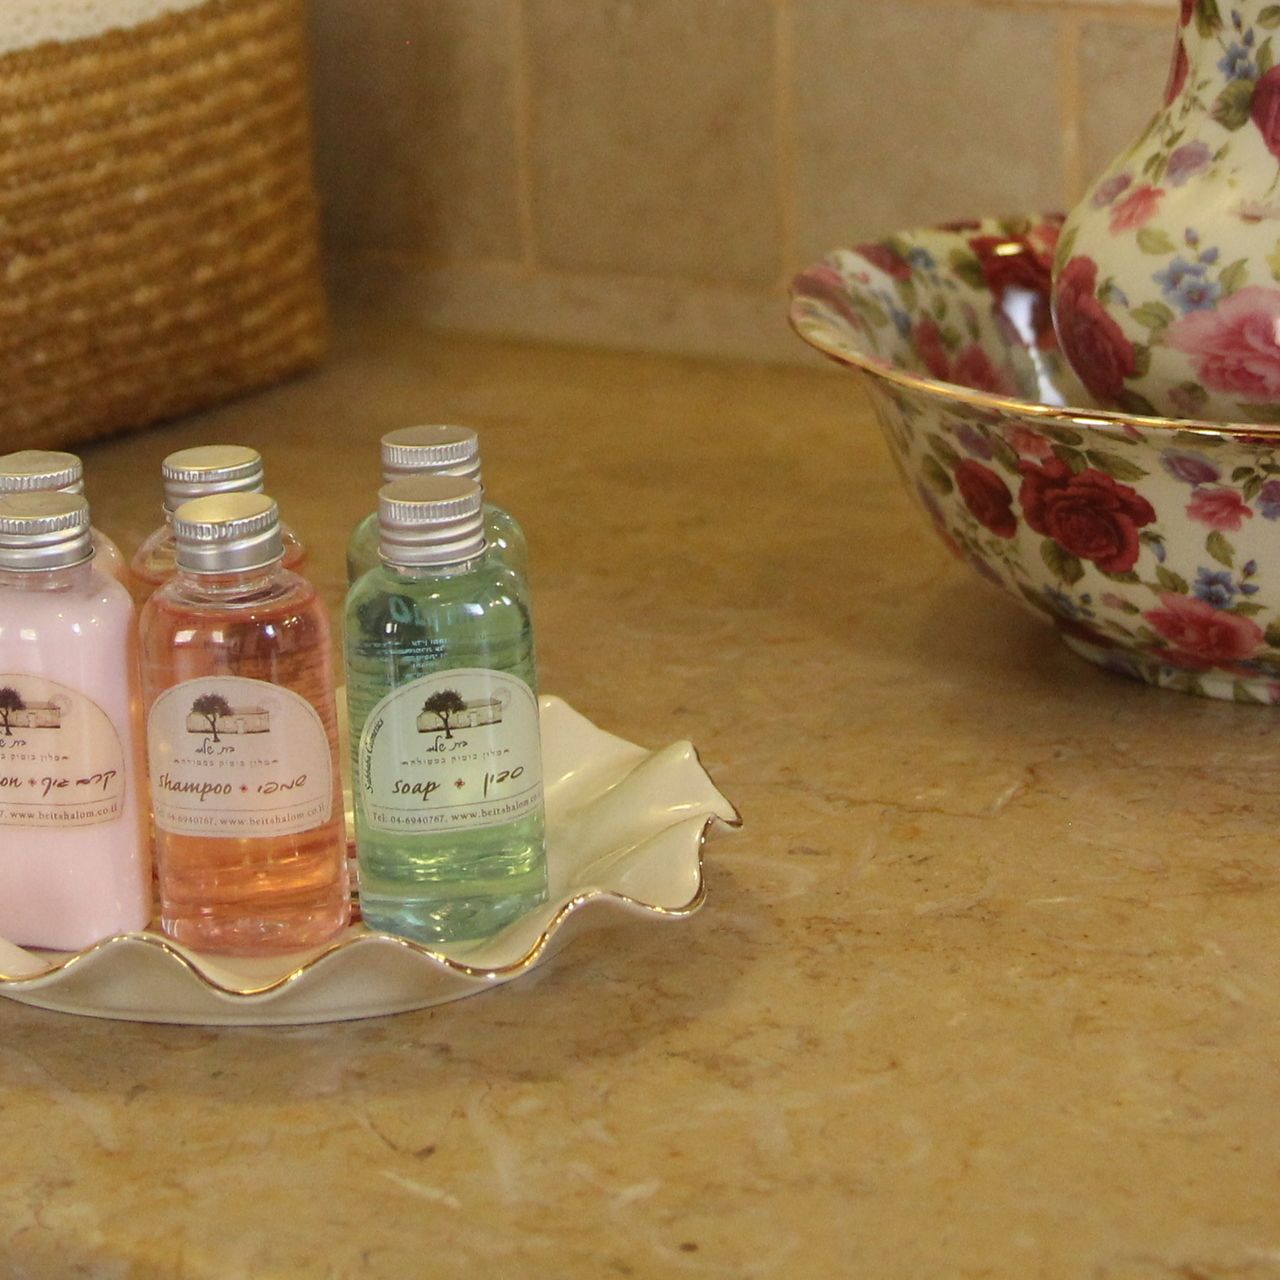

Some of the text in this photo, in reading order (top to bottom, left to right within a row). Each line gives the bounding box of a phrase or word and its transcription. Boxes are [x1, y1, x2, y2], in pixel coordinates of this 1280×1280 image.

[41, 770, 117, 798] קרם גוף
[257, 774, 307, 795] שמפו
[483, 766, 524, 799] סבון
